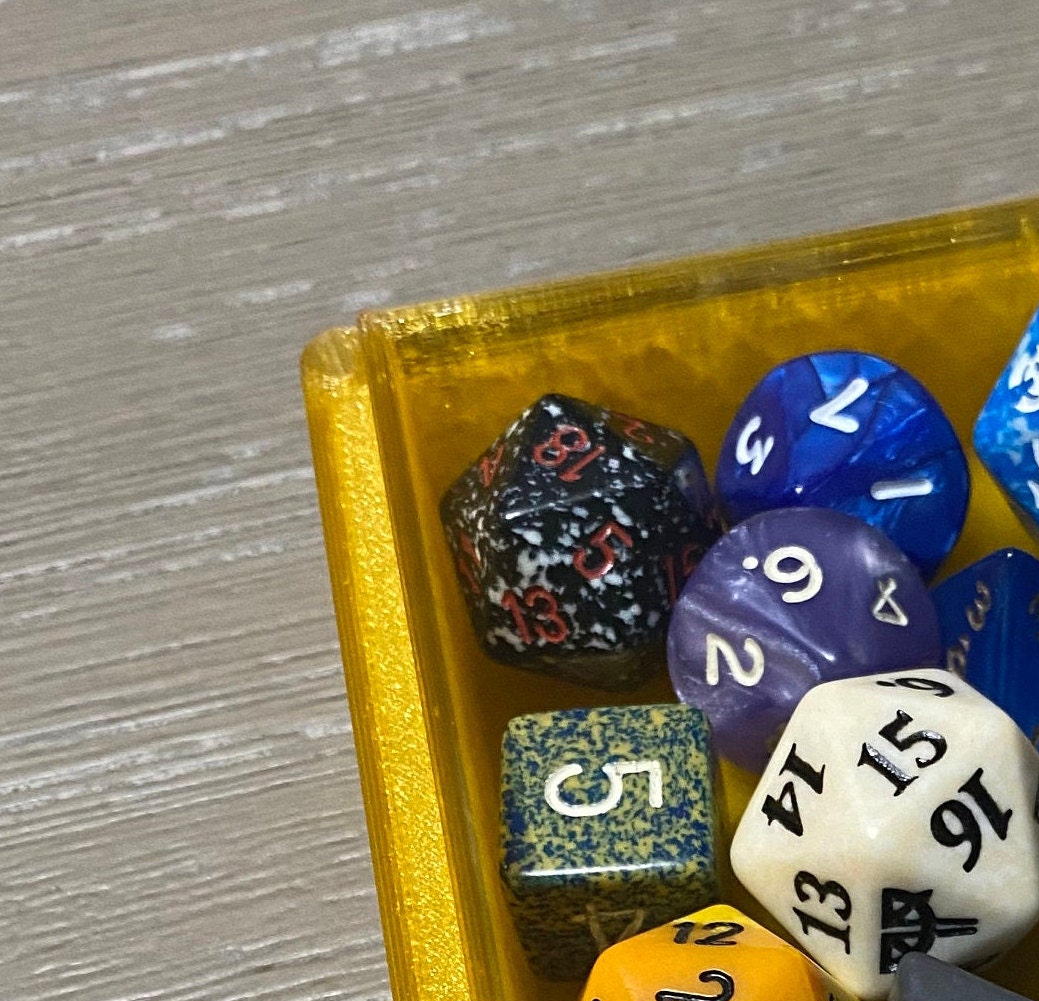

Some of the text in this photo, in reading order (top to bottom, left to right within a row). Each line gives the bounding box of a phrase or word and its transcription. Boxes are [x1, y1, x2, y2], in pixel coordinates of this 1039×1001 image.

[810, 378, 869, 433] 7
[533, 425, 605, 482] 18
[735, 416, 774, 475] 3
[870, 478, 933, 501] 1
[573, 521, 634, 580] 5
[501, 587, 567, 645] 13
[872, 577, 909, 627] 4
[706, 633, 765, 687] 2
[857, 709, 948, 797] 15
[544, 760, 663, 818] 5
[761, 743, 826, 837] 14
[930, 768, 1013, 873] 16
[672, 921, 745, 946] 12
[791, 870, 852, 955] 13
